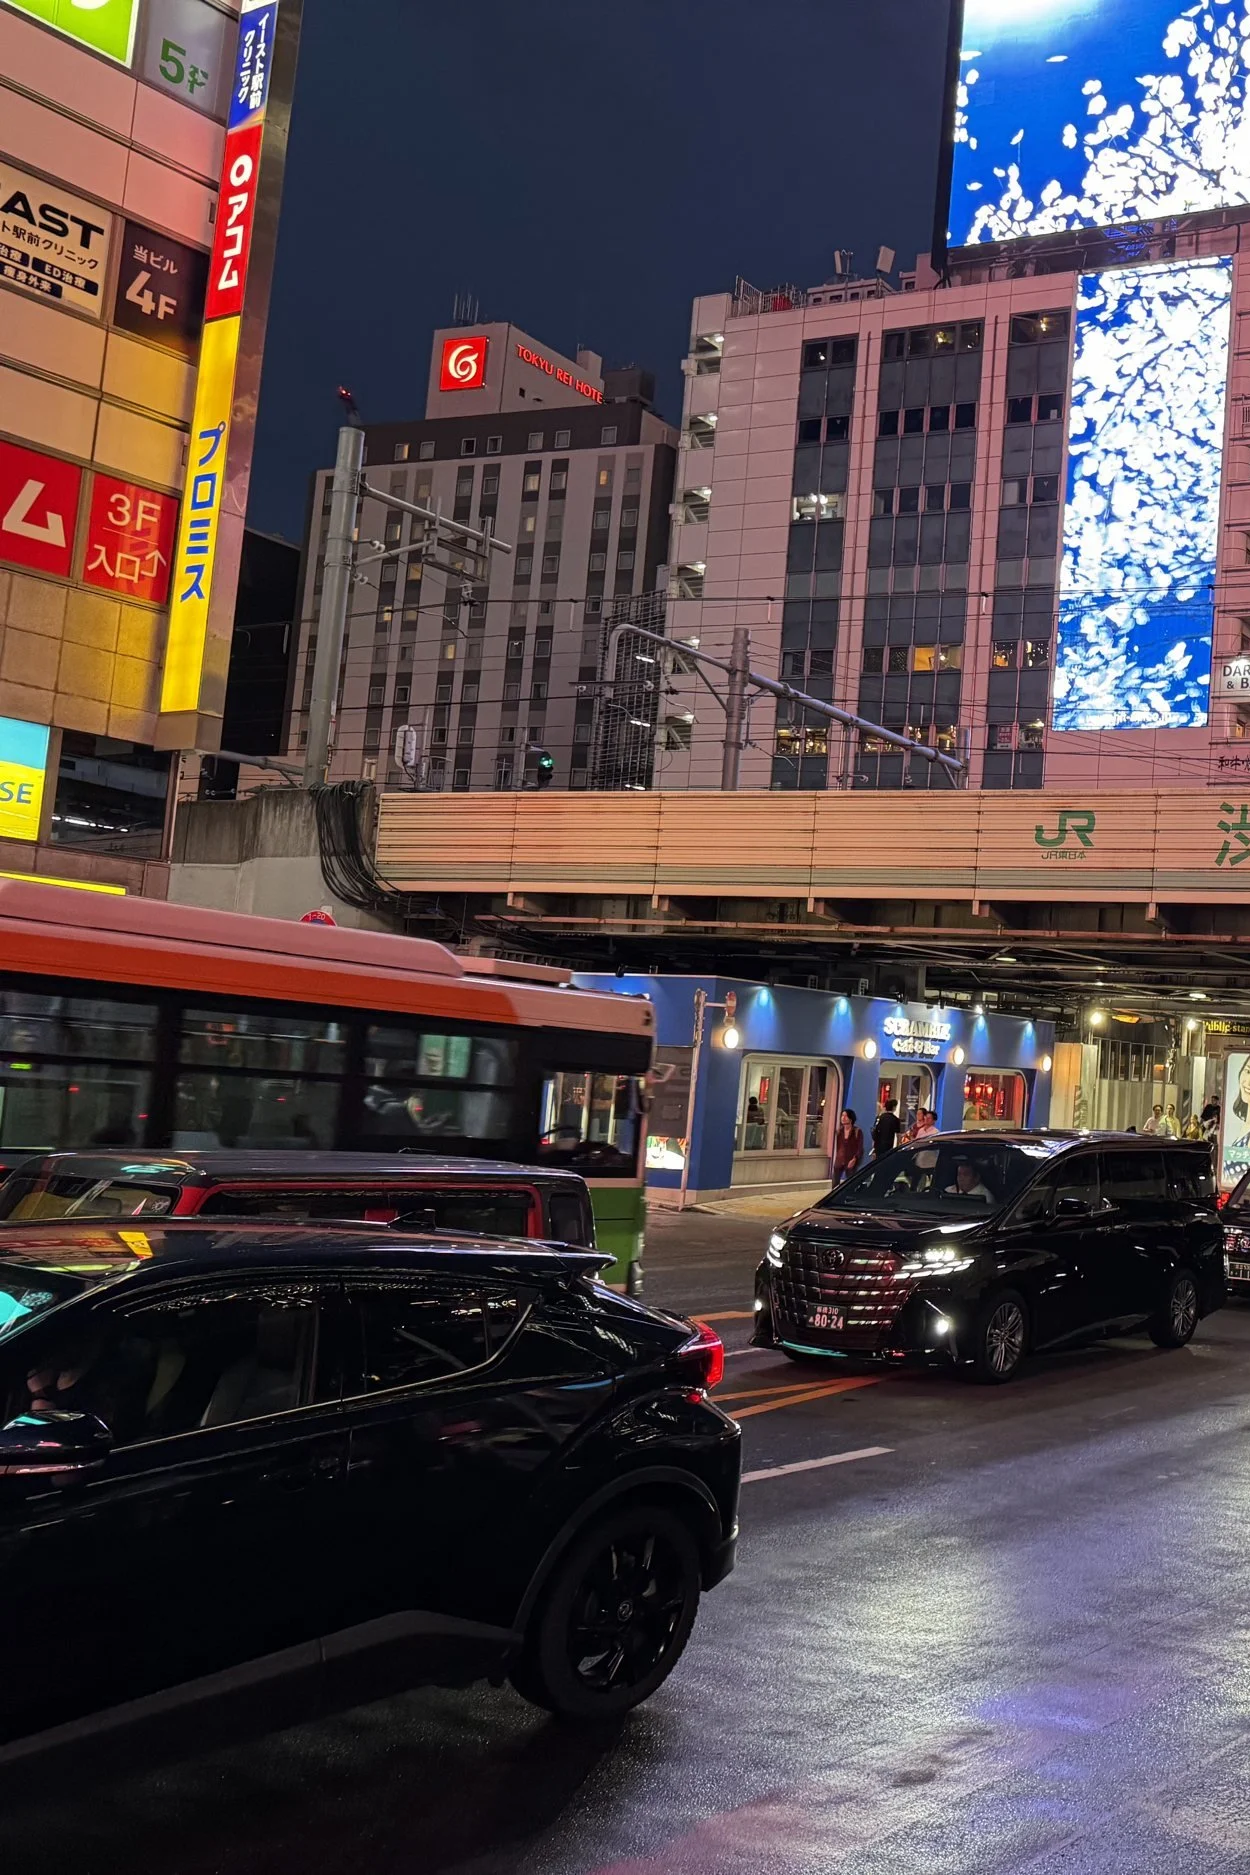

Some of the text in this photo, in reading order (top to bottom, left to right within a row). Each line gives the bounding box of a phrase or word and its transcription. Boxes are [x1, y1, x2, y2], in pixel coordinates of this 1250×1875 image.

[238, 30, 256, 103] クリニック
[249, 12, 270, 109] イースト駅前
[133, 245, 178, 275] 当ビル
[218, 194, 248, 291] アコム
[125, 271, 177, 320] 4F
[517, 344, 554, 375] TOKYU
[556, 368, 573, 386] REI
[107, 493, 161, 531] 3F
[180, 421, 226, 602] プロミス
[87, 544, 141, 584] 入口
[1227, 681, 1235, 690] &
[0, 781, 34, 804] SE
[1034, 810, 1096, 847] JR
[1041, 850, 1086, 860] JR東日本
[883, 1017, 951, 1041] SCRAMBLE
[923, 1040, 940, 1056] Bar
[814, 1313, 844, 1329] 80-24
